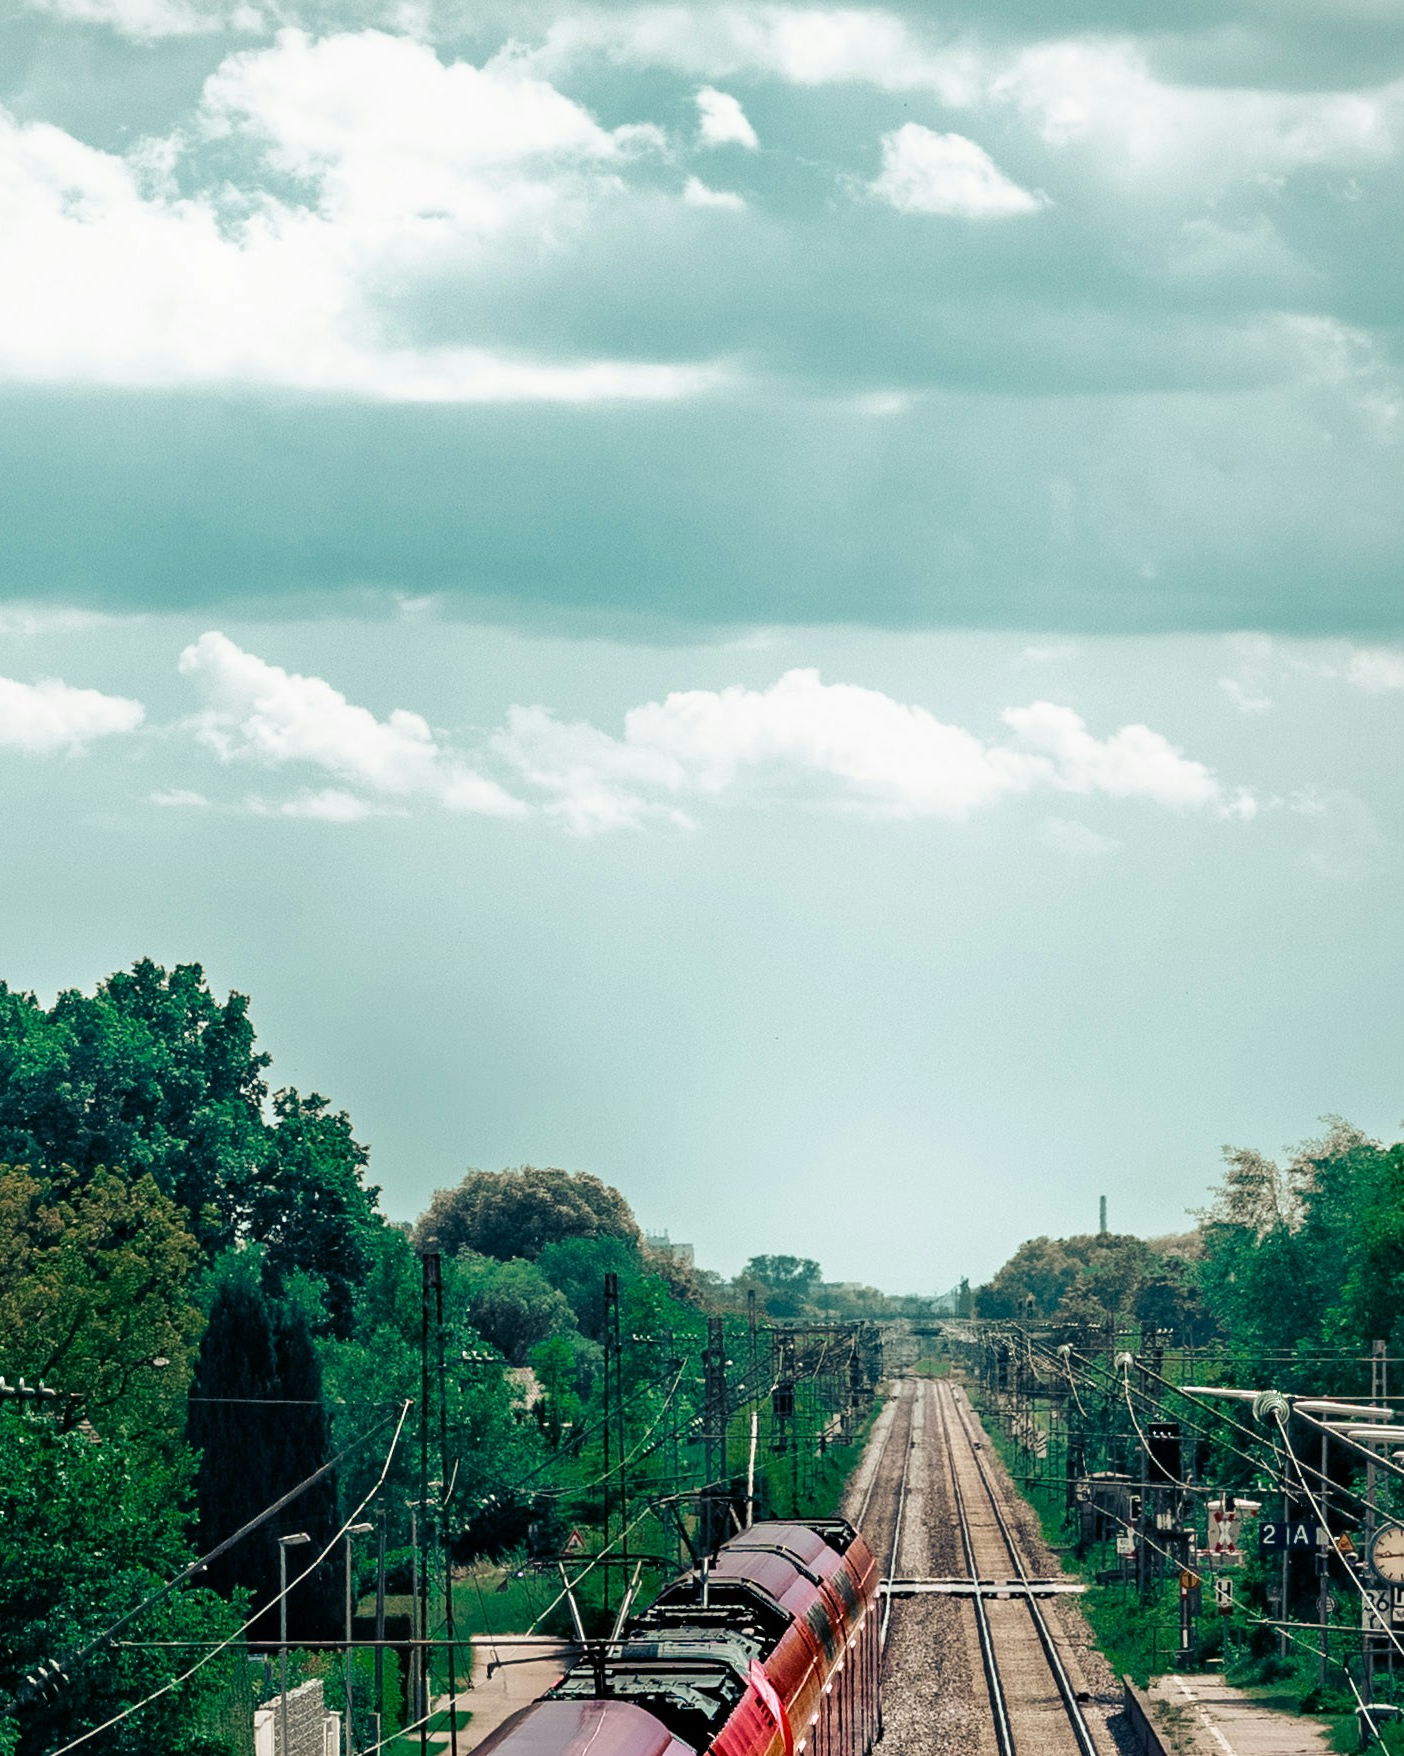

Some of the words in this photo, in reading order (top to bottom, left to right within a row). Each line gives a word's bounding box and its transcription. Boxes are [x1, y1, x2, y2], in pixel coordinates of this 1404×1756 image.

[1262, 1524, 1276, 1544] 2
[1293, 1524, 1309, 1545] A
[1217, 1581, 1231, 1602] H
[1364, 1591, 1389, 1612] 36
